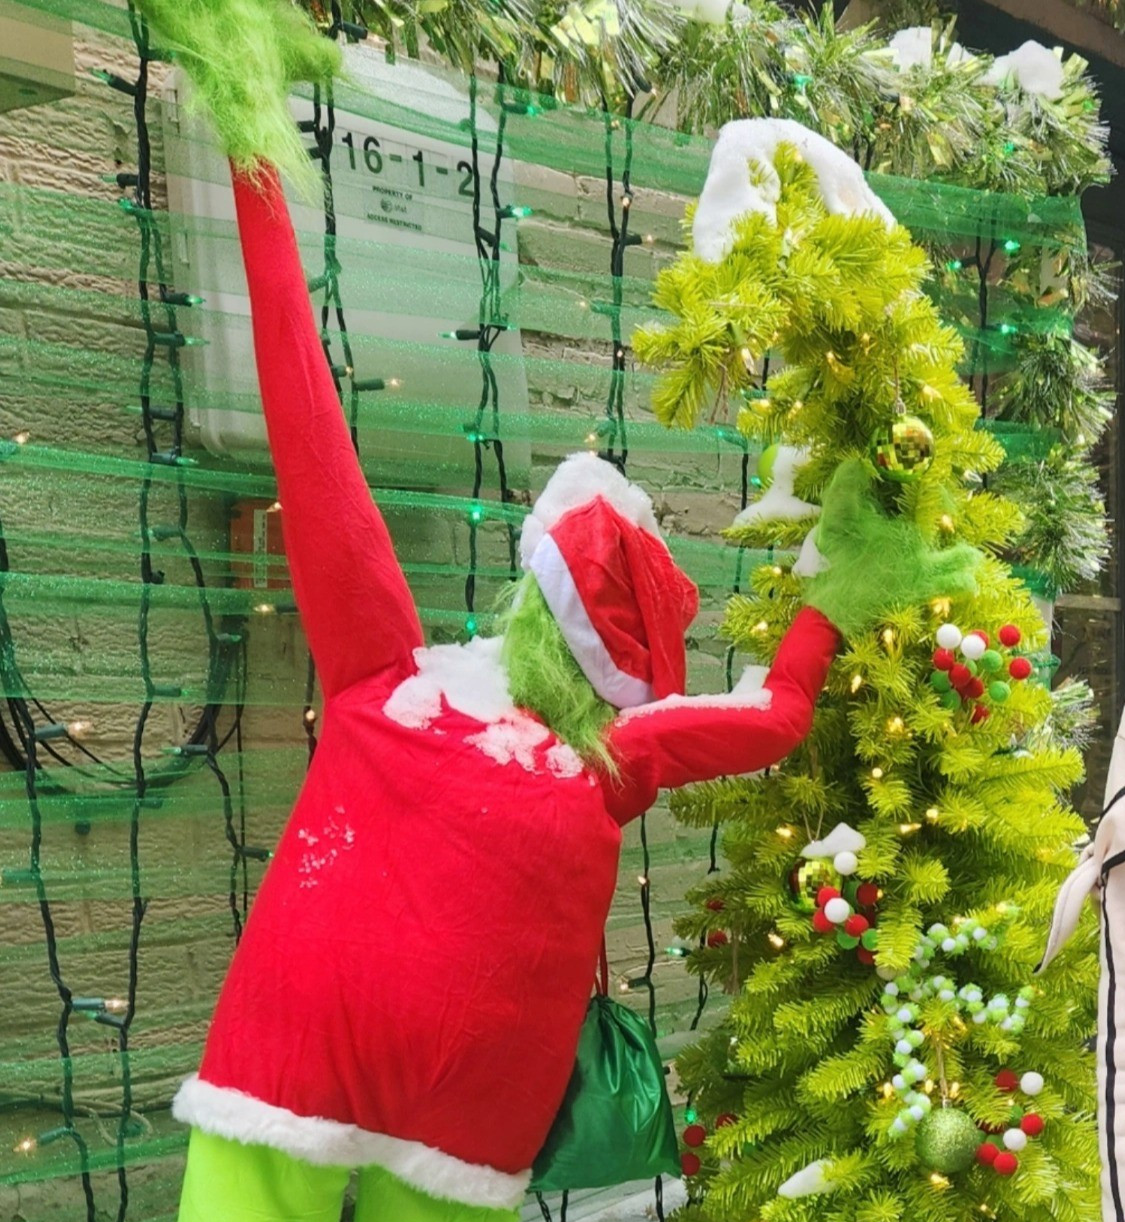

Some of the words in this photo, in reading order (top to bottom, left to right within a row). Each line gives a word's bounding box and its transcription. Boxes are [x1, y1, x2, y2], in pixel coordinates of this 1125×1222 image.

[341, 131, 474, 197] 16-1-2
[372, 185, 403, 198] PROPERTY
[404, 192, 413, 201] OF
[367, 212, 388, 223] ACCESS
[389, 218, 422, 232] RESTRICTED
